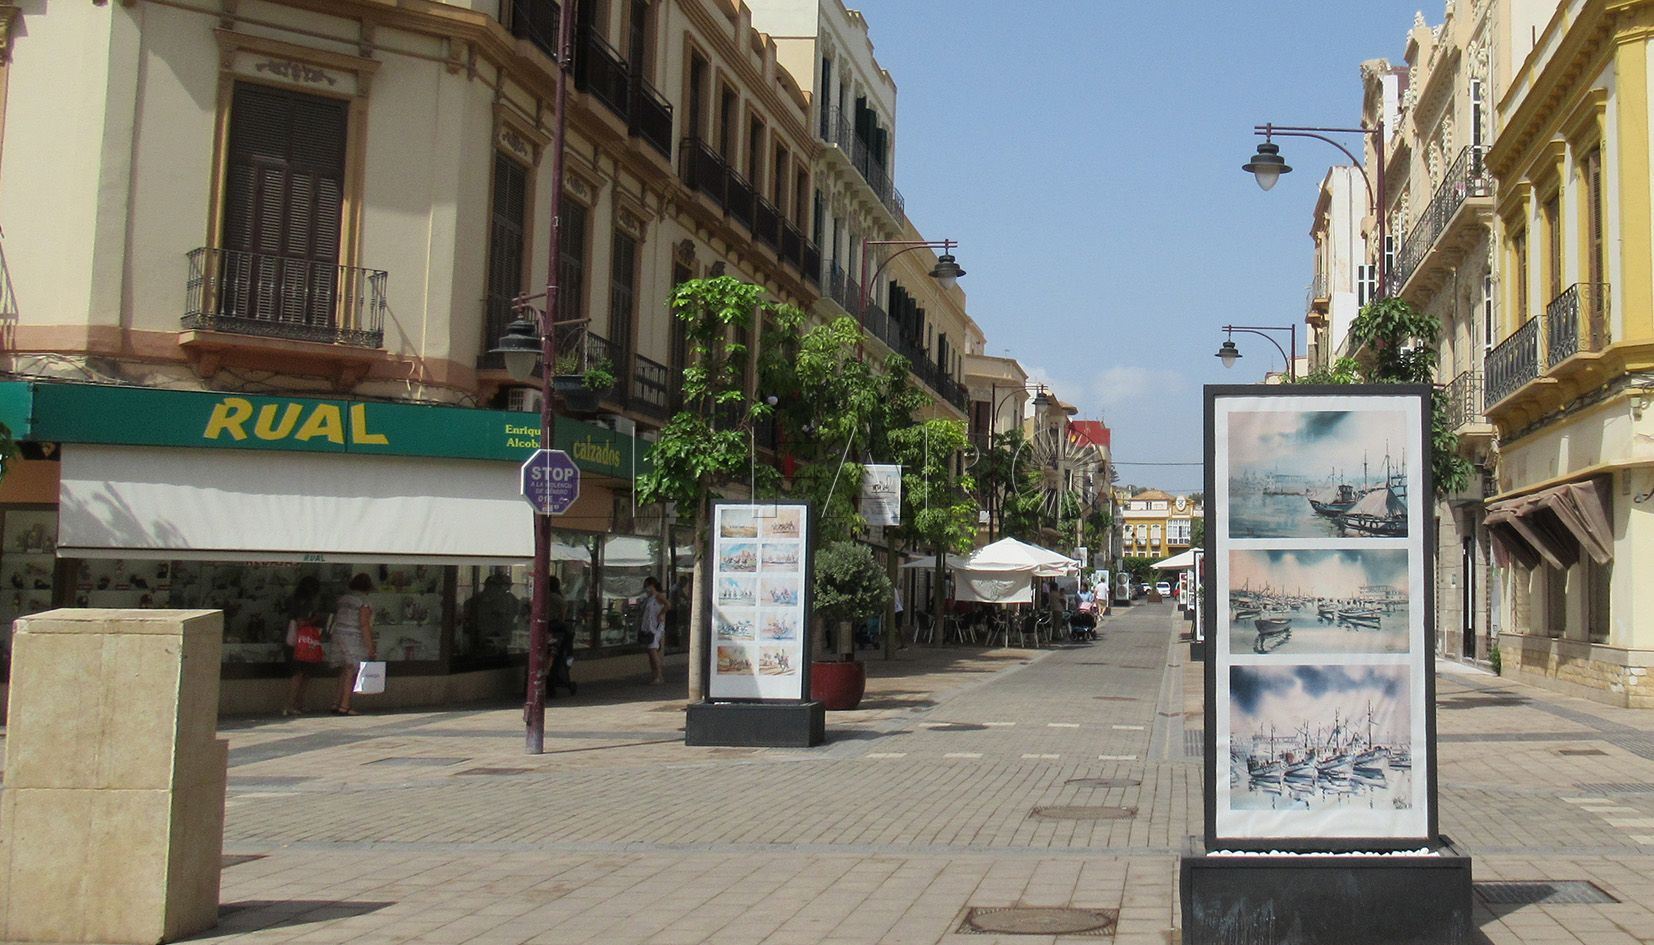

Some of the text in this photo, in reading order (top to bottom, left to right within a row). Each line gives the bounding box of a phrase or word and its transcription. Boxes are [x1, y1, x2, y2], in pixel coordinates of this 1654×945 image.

[203, 397, 389, 445] RUAL
[505, 424, 541, 437] Enriqu
[506, 437, 541, 449] Alcob
[573, 434, 621, 467] calzados
[531, 466, 574, 482] STOP
